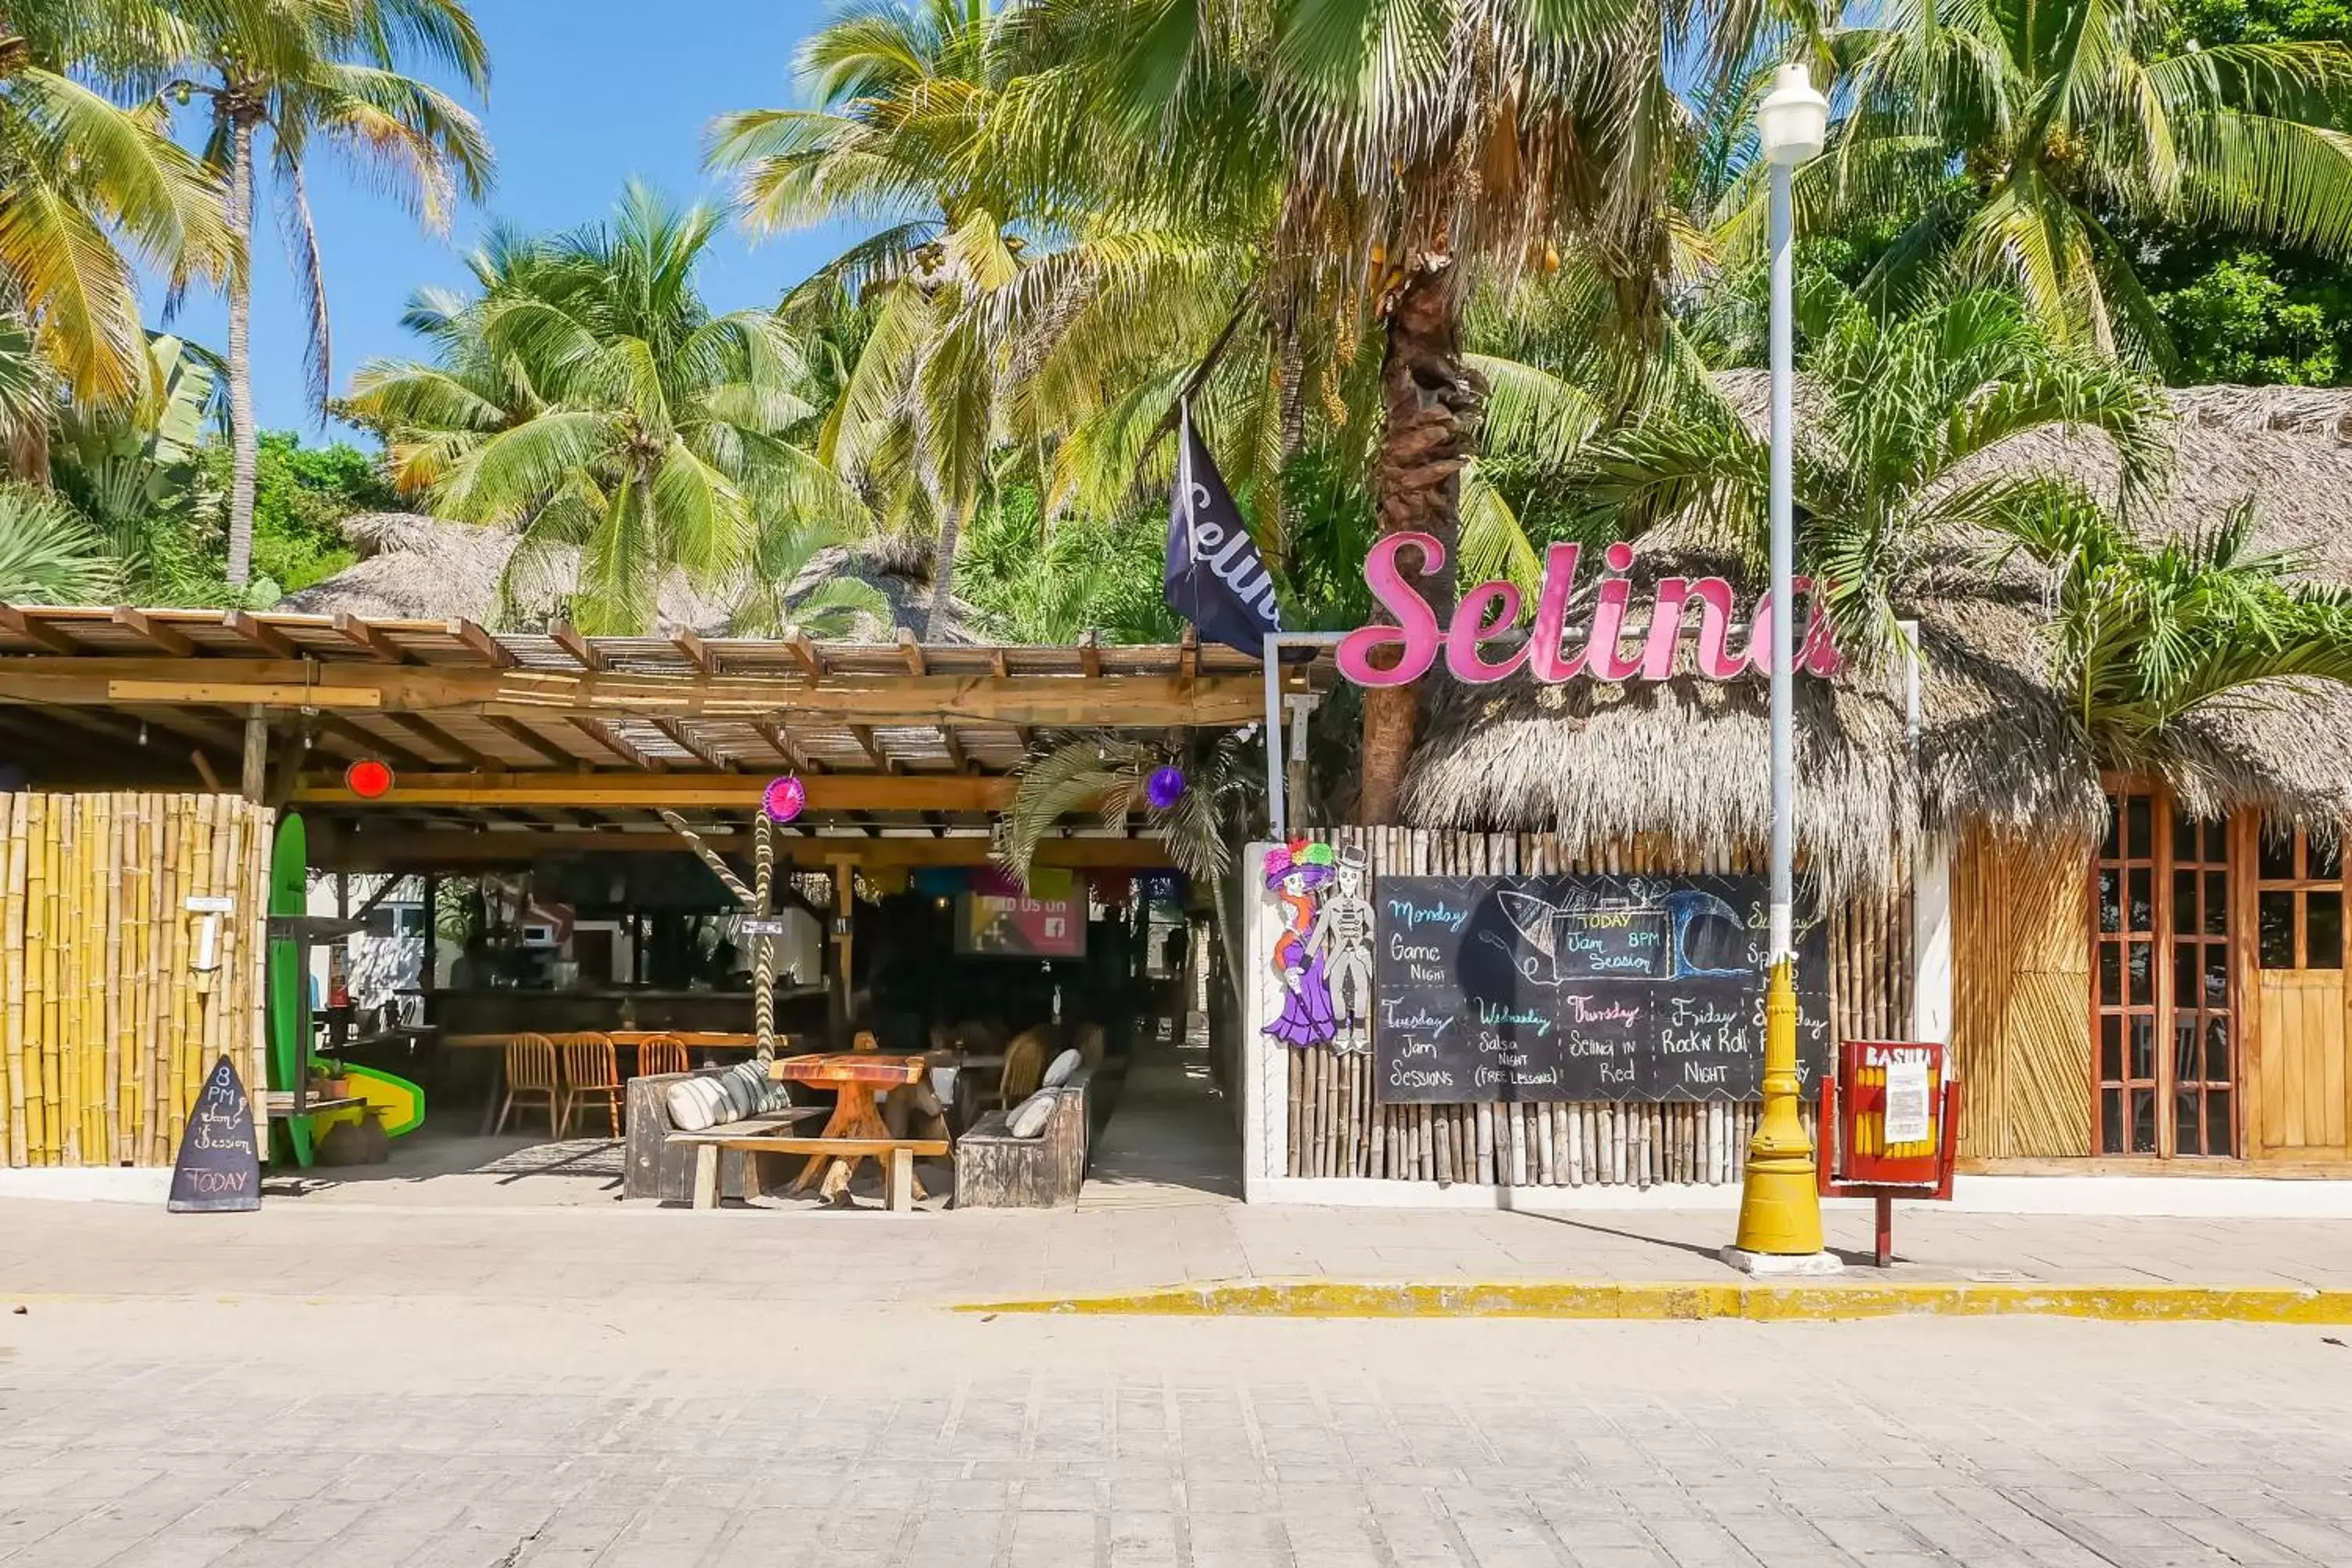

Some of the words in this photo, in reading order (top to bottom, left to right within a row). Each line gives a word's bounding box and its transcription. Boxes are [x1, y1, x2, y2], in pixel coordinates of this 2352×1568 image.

[1336, 531, 1844, 688] Selina
[1388, 899, 1468, 932] Monday
[1577, 914, 1632, 929] TODAY
[1391, 932, 1441, 961] Game
[1568, 931, 1606, 954] Jam
[1628, 931, 1660, 948] 8PM
[1589, 953, 1651, 974] Session
[1381, 996, 1454, 1039] Tuesday
[1568, 995, 1640, 1028] Thursday
[1671, 997, 1737, 1029] Friday
[1400, 1034, 1437, 1058] Jam
[1479, 1031, 1519, 1053] Salsa
[1498, 1051, 1529, 1067] NIGHT
[1599, 1058, 1635, 1083] Red
[1685, 1060, 1729, 1083] NIGHT
[216, 1066, 230, 1086] 8
[208, 1086, 234, 1105] PM
[201, 1102, 242, 1130] Jam
[194, 1124, 252, 1154] Session
[182, 1167, 248, 1192] TODAY
